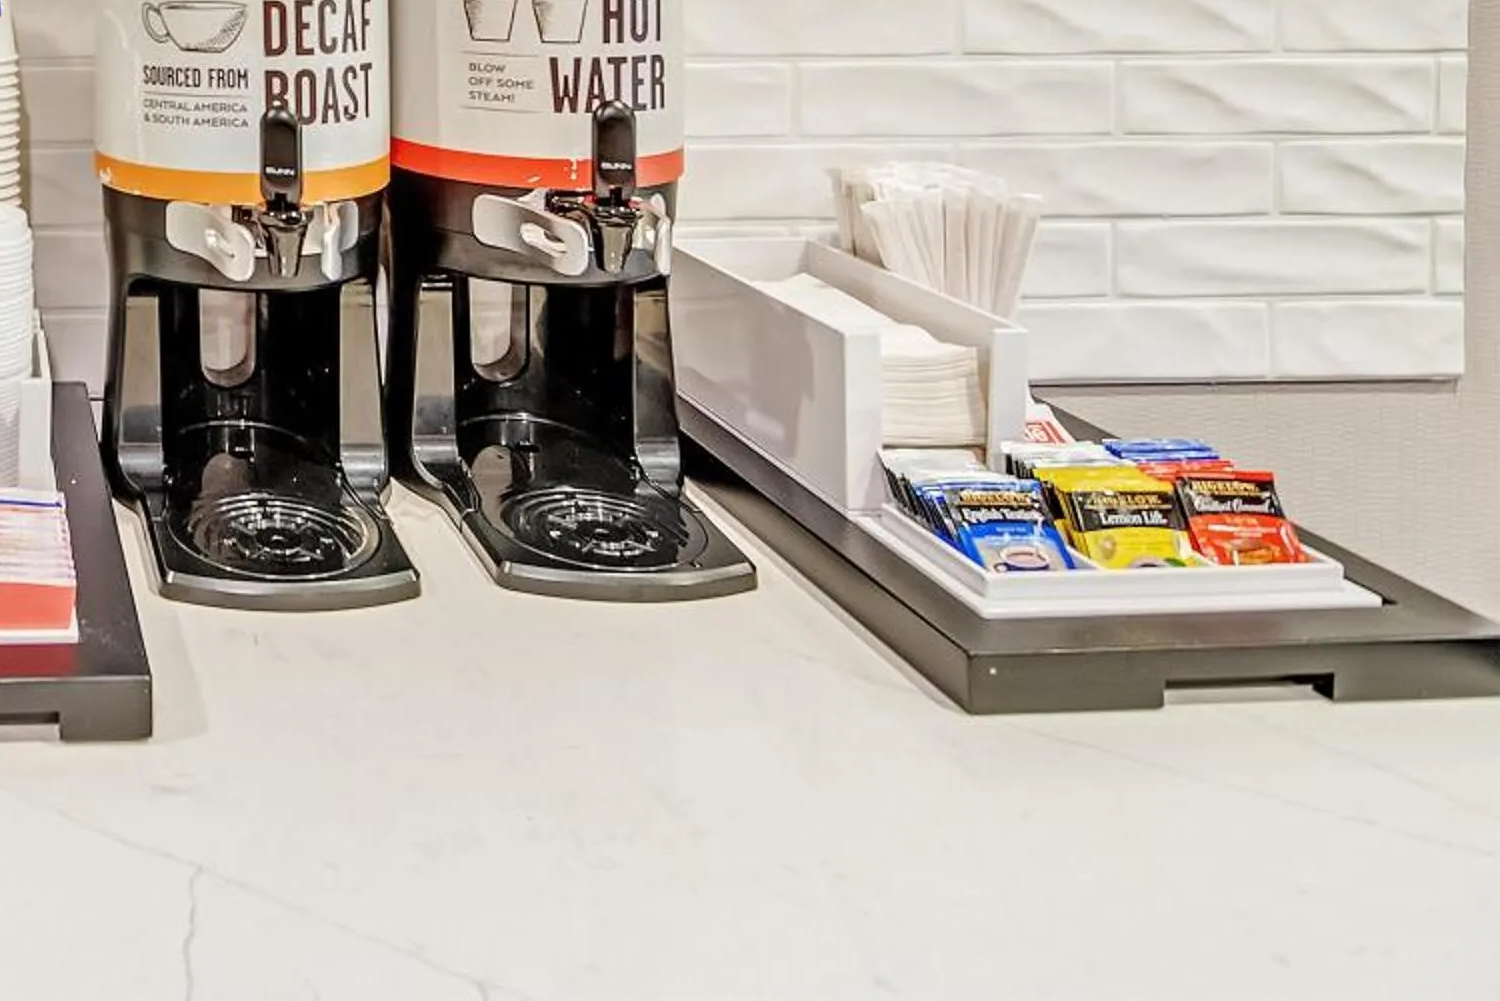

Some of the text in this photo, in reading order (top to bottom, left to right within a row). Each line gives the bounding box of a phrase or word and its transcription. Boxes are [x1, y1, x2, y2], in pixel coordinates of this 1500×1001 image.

[469, 62, 506, 72] BLOW
[142, 65, 249, 89] SOURCED FROM
[468, 76, 535, 89] OFF SOME
[549, 55, 665, 113] WATER
[264, 63, 372, 126] ROAST
[468, 90, 516, 103] STEAM!
[143, 99, 248, 113] CENTRAL AMERICA
[152, 114, 190, 126] SOUTH
[193, 117, 249, 128] AMERICA
[1100, 511, 1141, 525] Lemon
